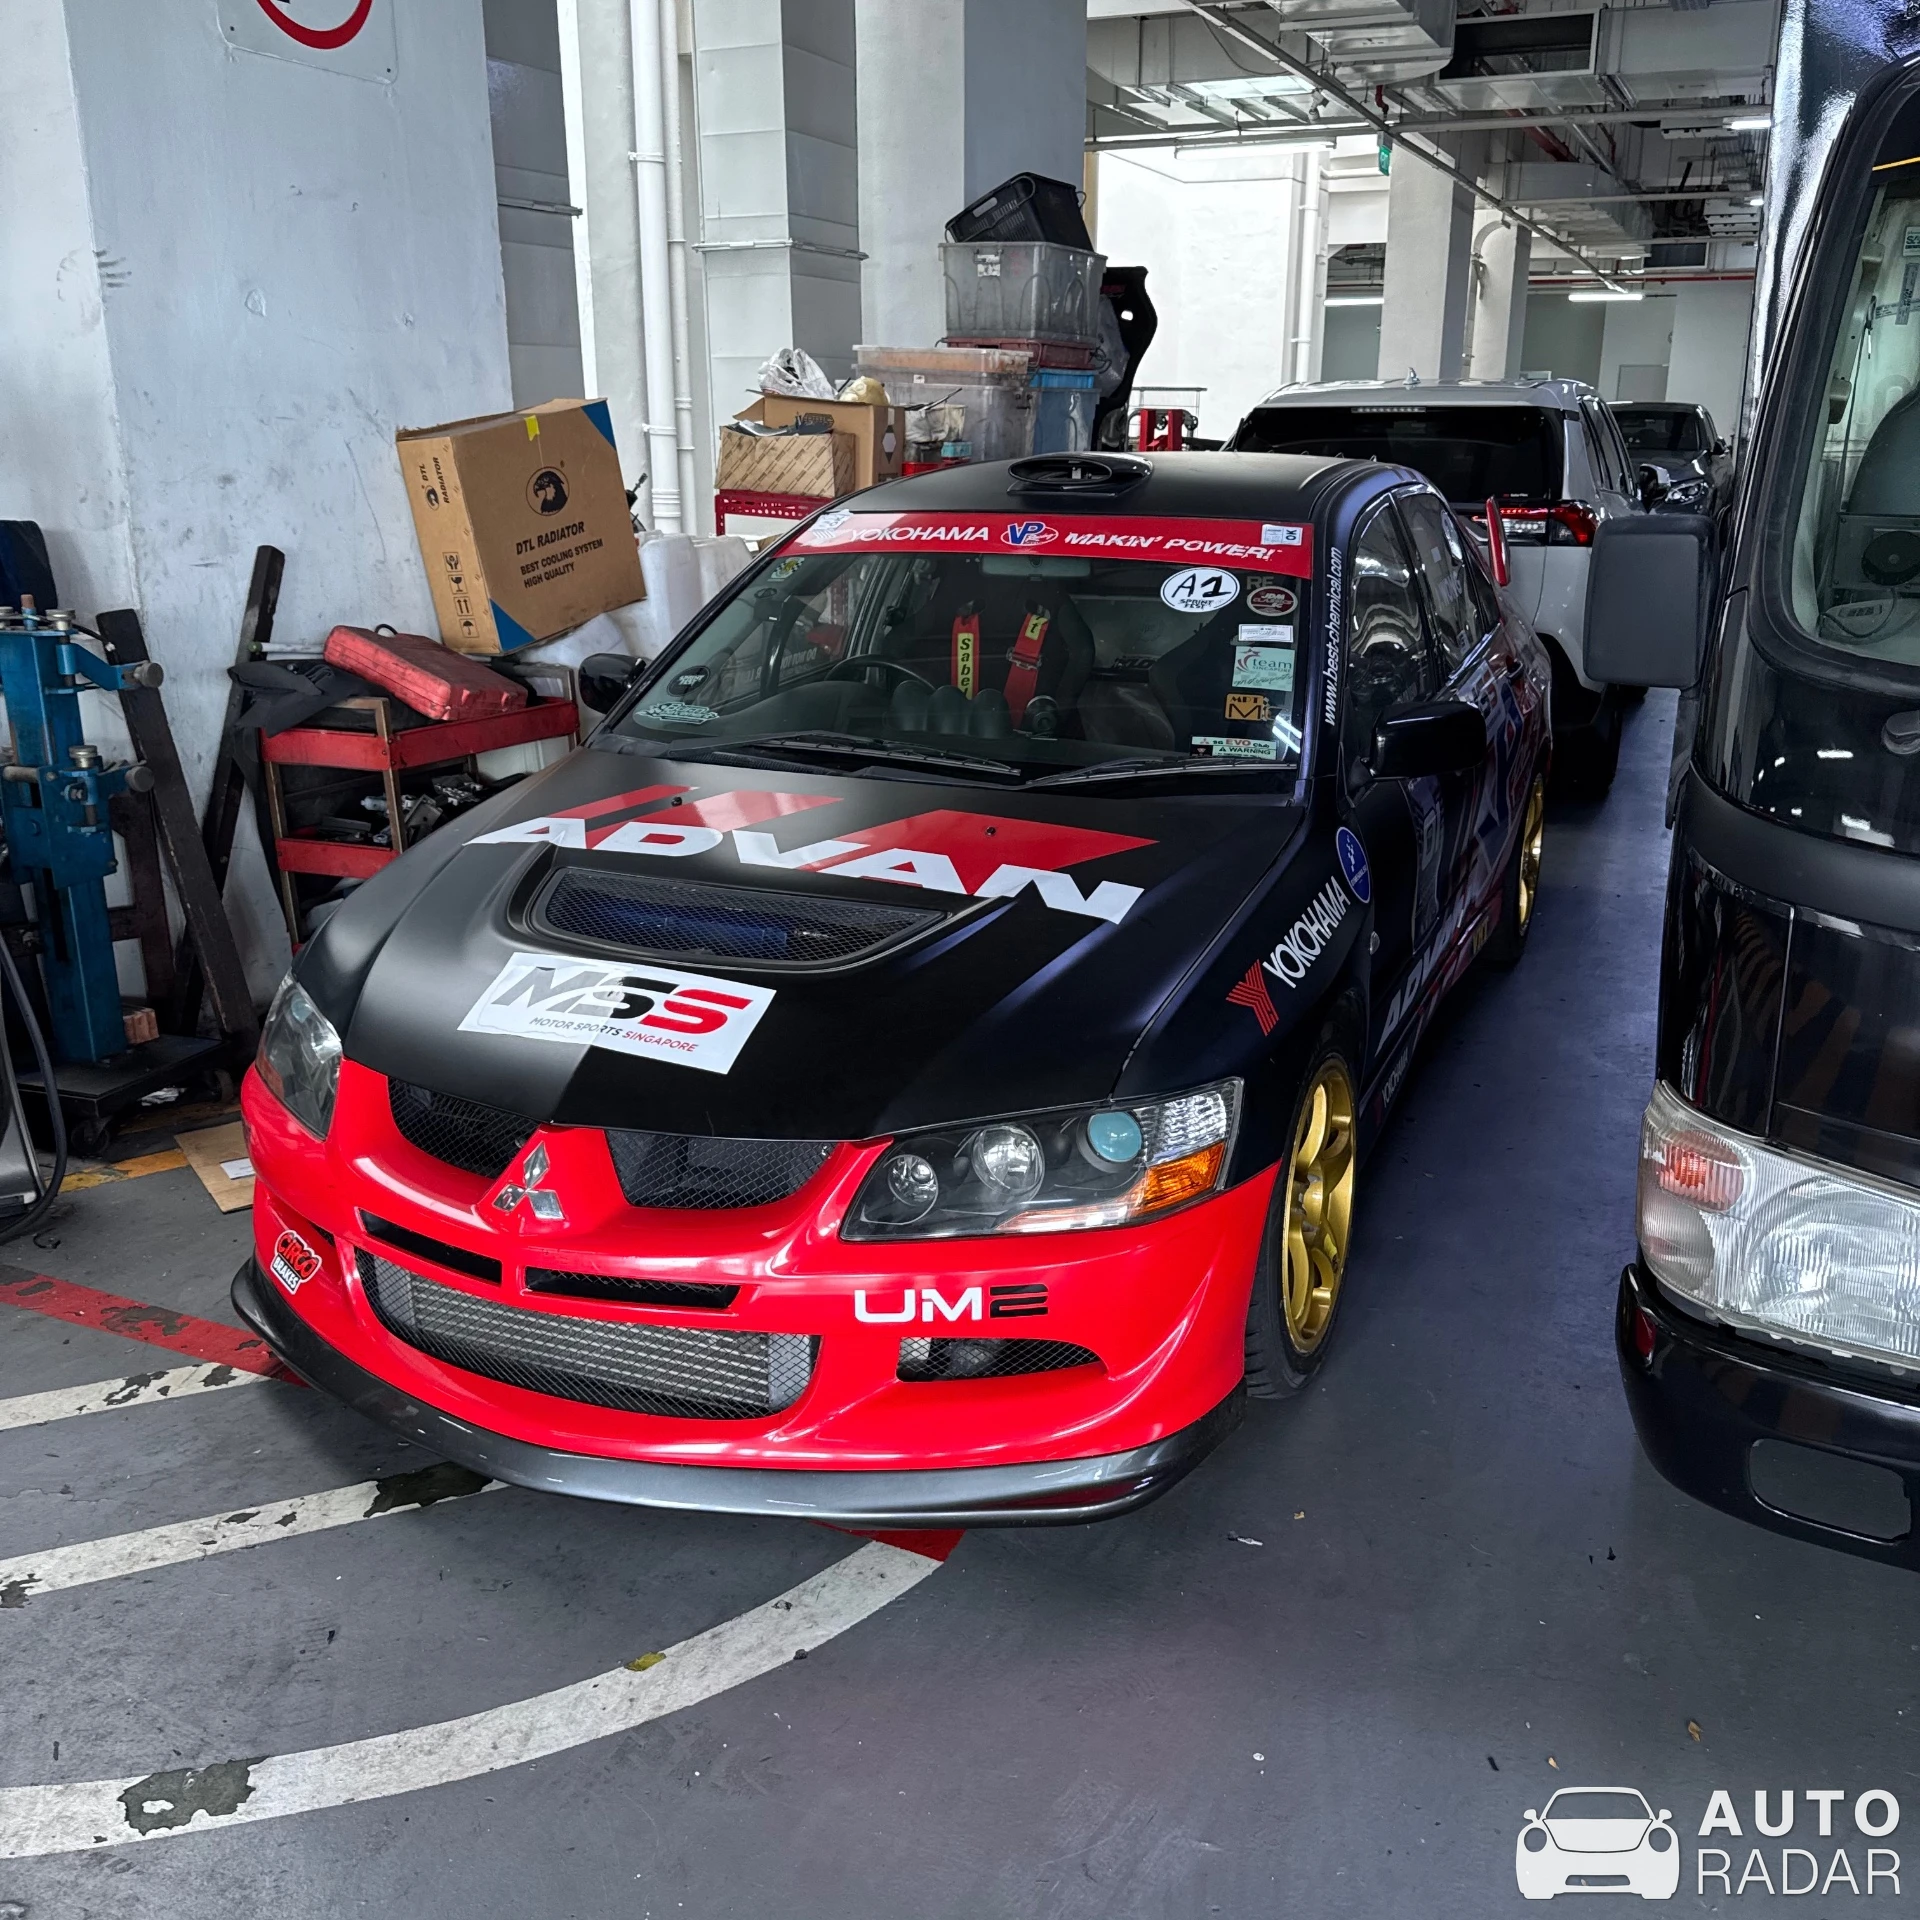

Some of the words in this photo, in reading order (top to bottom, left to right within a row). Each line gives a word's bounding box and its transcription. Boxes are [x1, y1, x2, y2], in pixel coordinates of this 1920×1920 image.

[418, 463, 429, 482] DTL
[432, 456, 450, 504] RADIATOR
[516, 537, 536, 556] DTL
[537, 521, 586, 549] RADIATOR
[850, 526, 989, 542] YOKOHAMA
[1285, 529, 1298, 541] OK
[520, 561, 541, 576] BEST
[541, 549, 574, 568] COOLING
[575, 538, 604, 556] SYSTEM
[523, 574, 544, 589] HIGH
[544, 562, 576, 582] QUALITY
[1171, 573, 1233, 599] A1
[1323, 546, 1343, 727] www.best-chemical.com
[1252, 658, 1292, 670] team
[1225, 738, 1252, 747] EVO
[1228, 747, 1271, 756] WARNING
[461, 816, 1145, 925] ADVAN
[1262, 875, 1351, 989] YOKOHAMA
[491, 966, 754, 1035] MSS
[529, 1016, 574, 1031] MOTOR
[573, 1021, 624, 1037] SPORTS
[622, 1030, 699, 1053] SINGAPORE
[272, 1256, 299, 1289] BRAKES
[854, 1283, 1049, 1323] UM2
